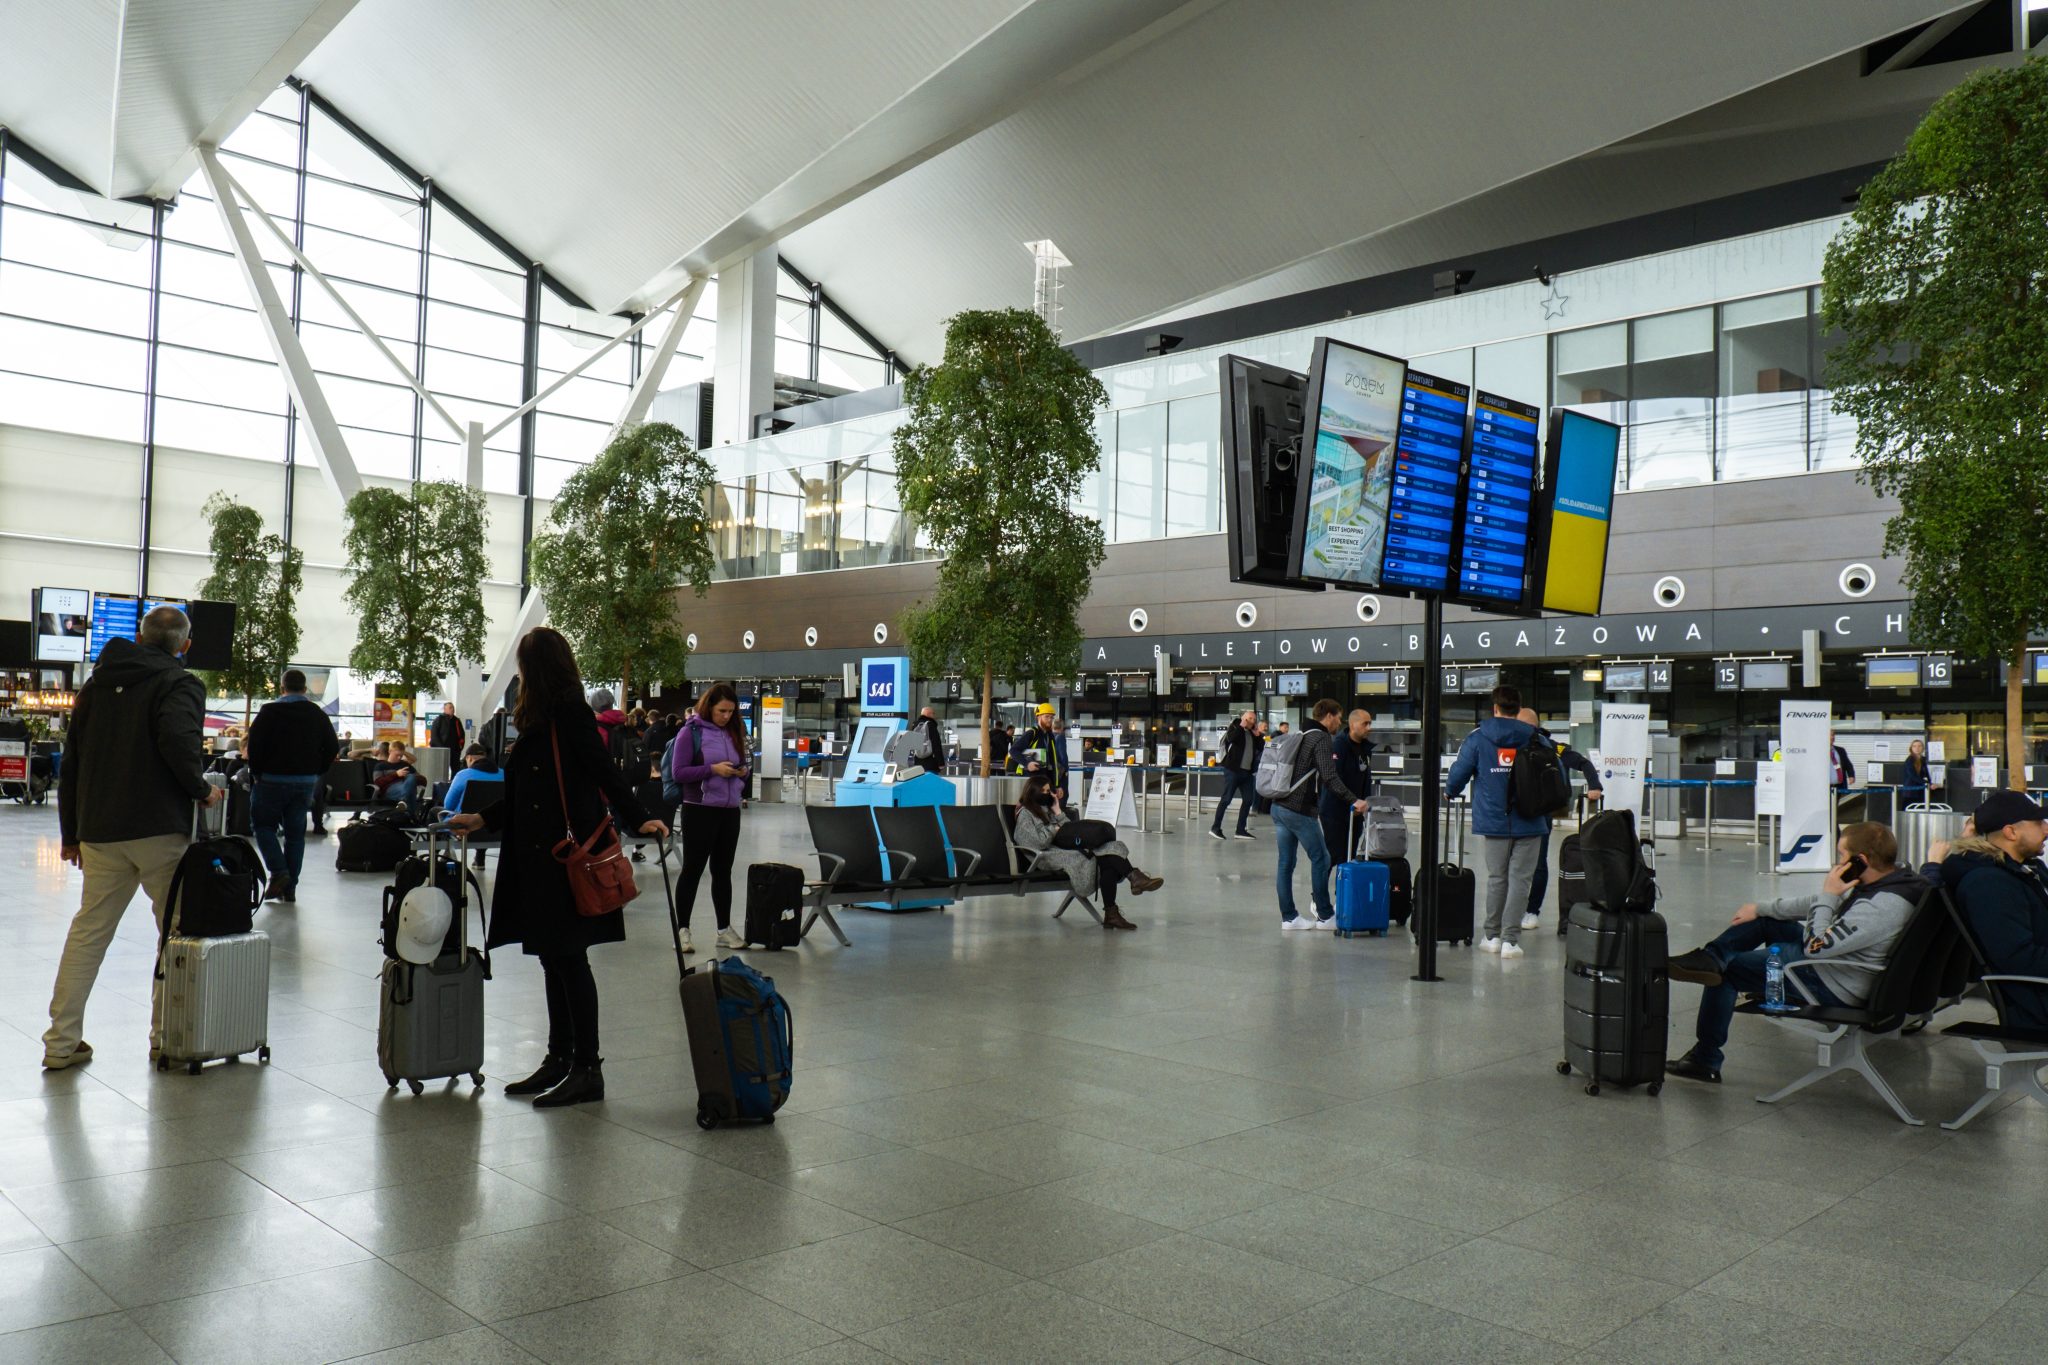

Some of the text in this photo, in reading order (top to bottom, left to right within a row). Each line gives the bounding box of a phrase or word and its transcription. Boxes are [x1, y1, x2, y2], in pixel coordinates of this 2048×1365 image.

[1344, 373, 1385, 395] FORUM
[1340, 526, 1364, 535] SHOPPING
[1331, 538, 1359, 546] EXPERIENCE
[1719, 668, 1735, 682] 15
[1927, 662, 1947, 678] 16
[1394, 675, 1406, 687] 12
[1445, 674, 1457, 687] 13
[1652, 669, 1668, 683] 14
[951, 682, 957, 692] 6
[1075, 681, 1081, 691] 8
[1111, 680, 1118, 691] 9
[1219, 678, 1229, 690] 10
[1264, 678, 1272, 689] 11
[753, 685, 758, 694] 2
[775, 685, 780, 694] 3
[868, 682, 893, 697] SAS
[1786, 711, 1828, 719] FINNAIR
[1604, 757, 1638, 766] PRIORITY
